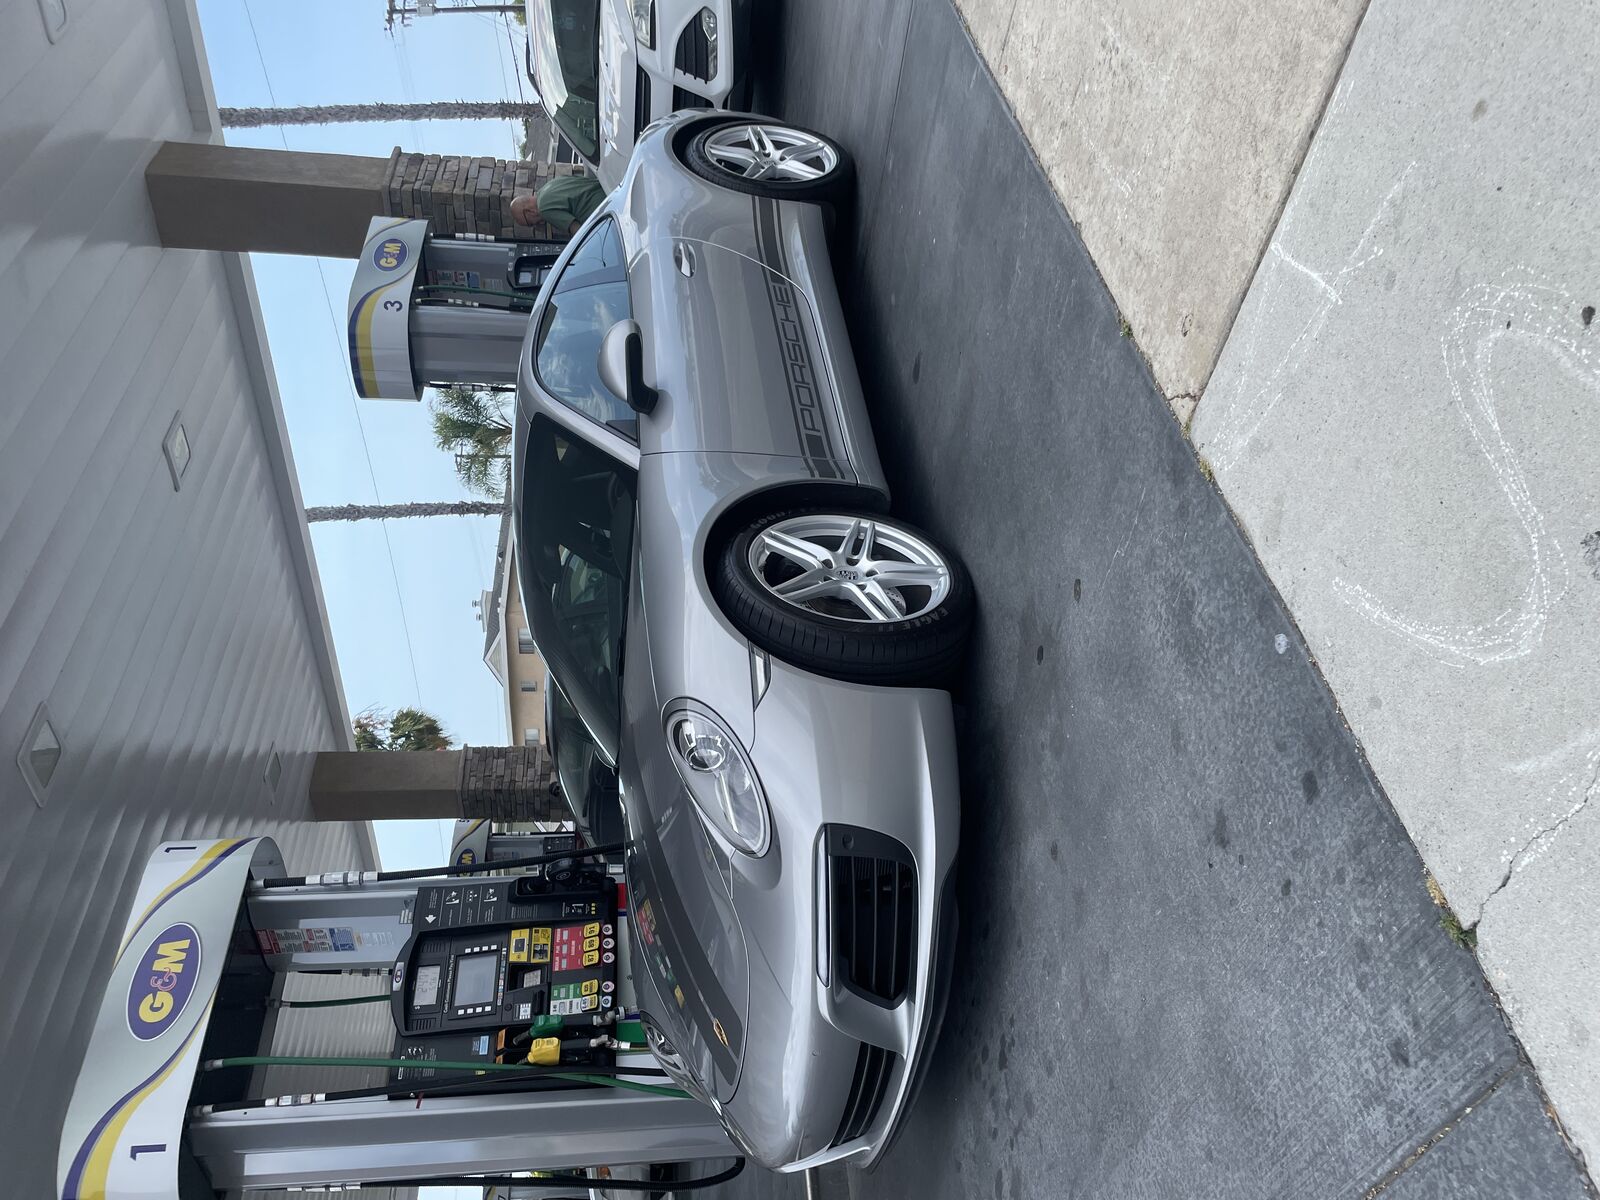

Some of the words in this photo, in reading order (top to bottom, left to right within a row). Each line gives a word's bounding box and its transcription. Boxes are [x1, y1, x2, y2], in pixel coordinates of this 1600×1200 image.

[380, 243, 402, 267] G&M
[384, 301, 402, 312] 3
[772, 285, 820, 432] PORSCHE
[164, 846, 198, 854] 1
[589, 926, 595, 934] 91
[588, 939, 595, 948] 89
[588, 954, 594, 963] 87
[138, 939, 191, 1023] G&M
[130, 1144, 166, 1161] 1
